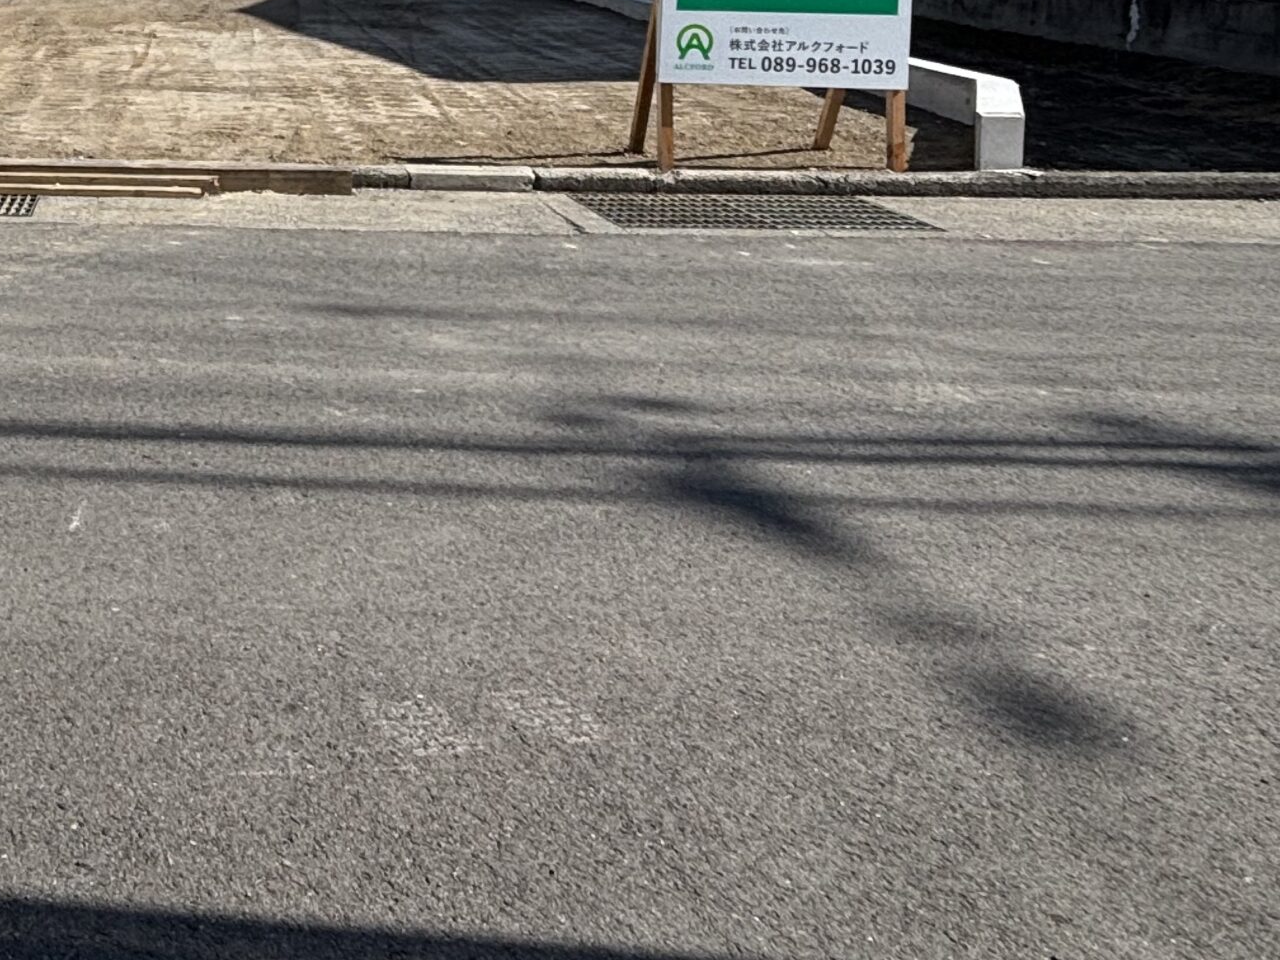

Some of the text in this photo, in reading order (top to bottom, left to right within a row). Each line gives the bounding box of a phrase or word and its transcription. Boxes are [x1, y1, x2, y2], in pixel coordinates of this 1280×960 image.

[729, 38, 869, 54] 株式会社アルクフォード
[728, 56, 896, 75] TEL 089-968-1039
